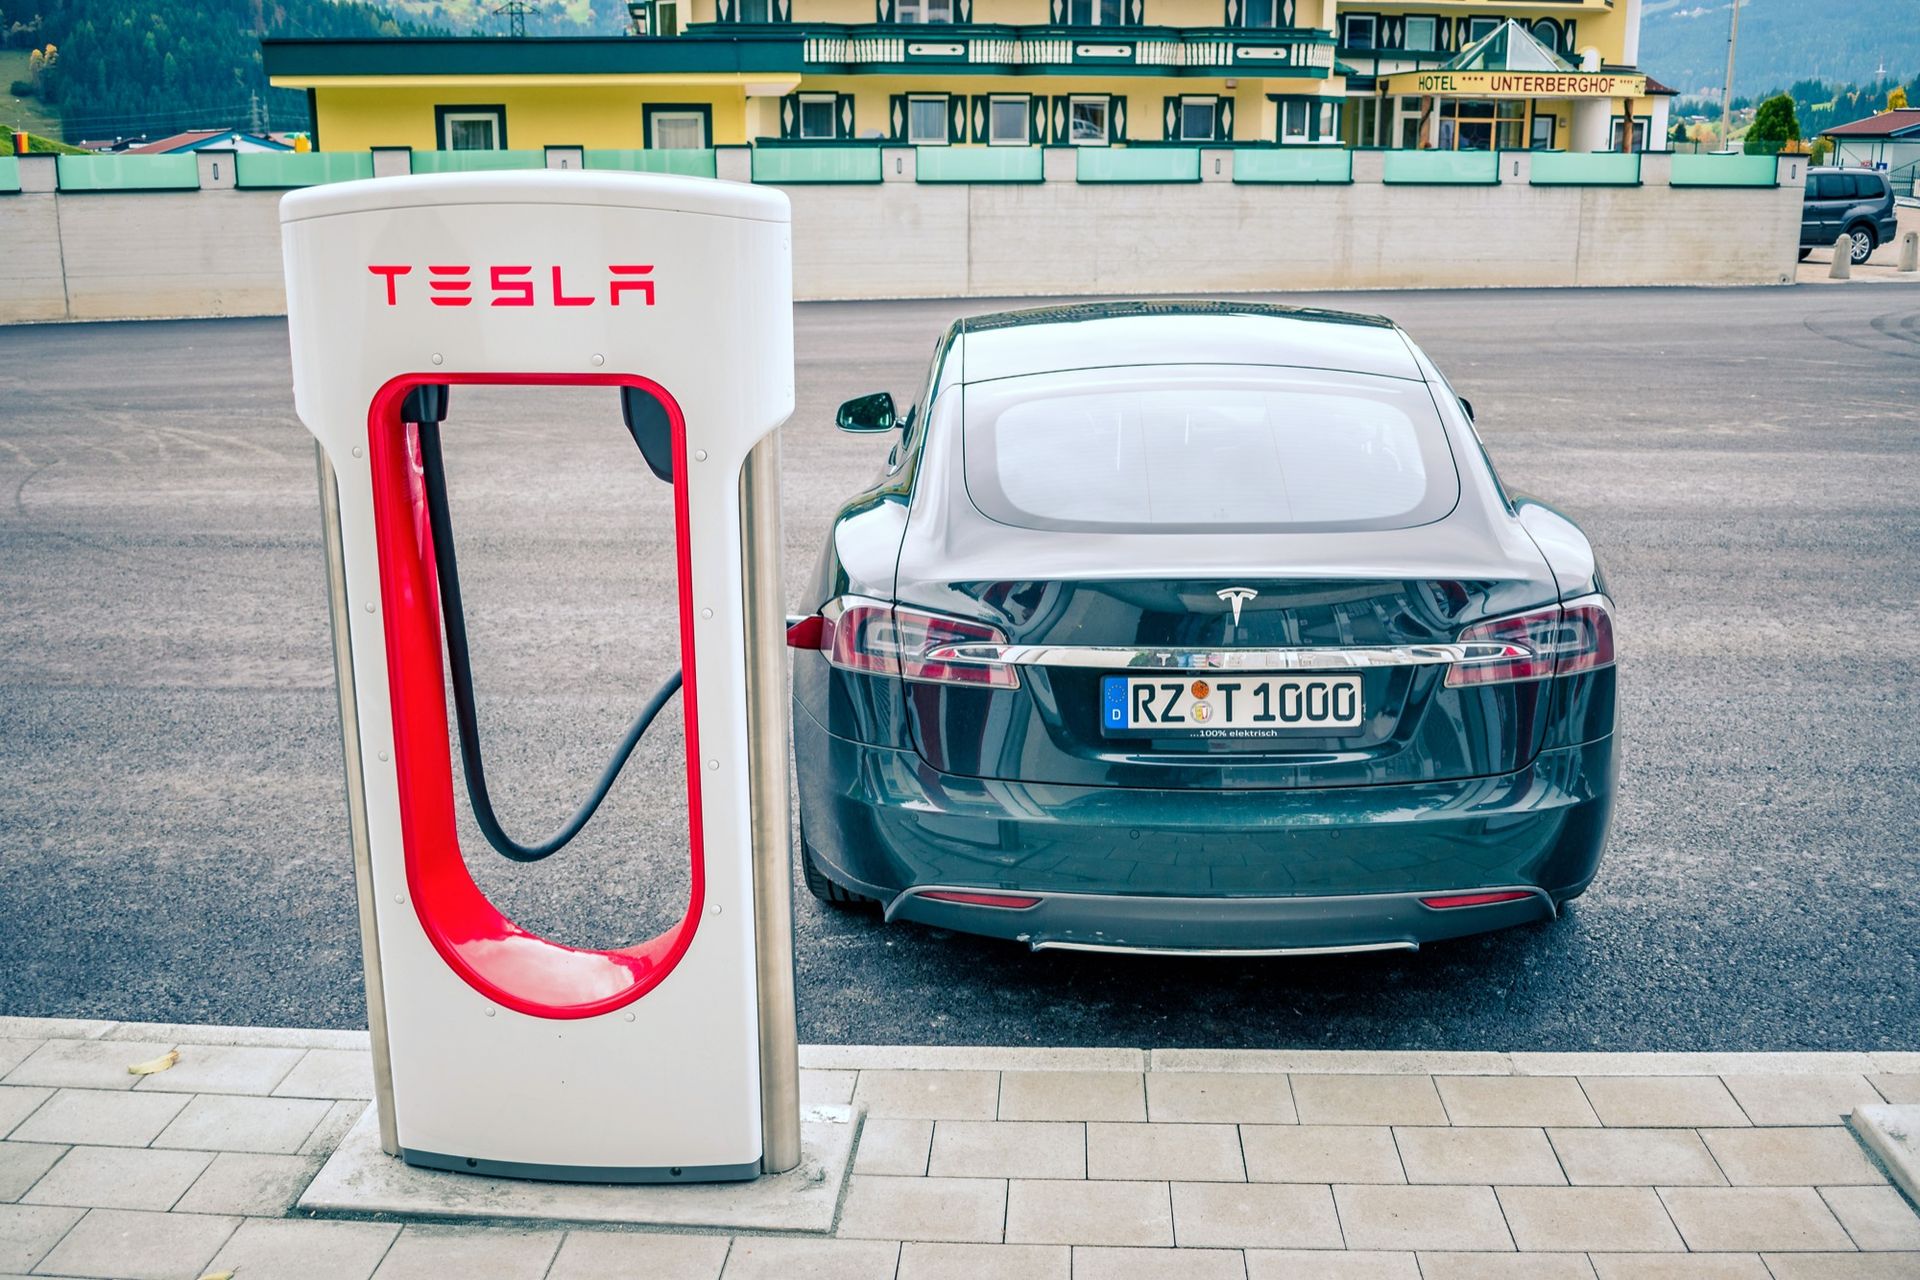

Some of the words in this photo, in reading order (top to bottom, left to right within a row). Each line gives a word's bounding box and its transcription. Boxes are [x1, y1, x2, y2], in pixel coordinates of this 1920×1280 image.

[1418, 75, 1457, 91] HOTEL
[1490, 76, 1616, 93] UNTERBERGHOF
[367, 264, 656, 306] TESLA
[1132, 683, 1186, 723] RZ
[1216, 683, 1242, 722] T
[1253, 682, 1356, 722] 1000
[1111, 708, 1121, 720] D
[1229, 729, 1278, 737] elektrisch
